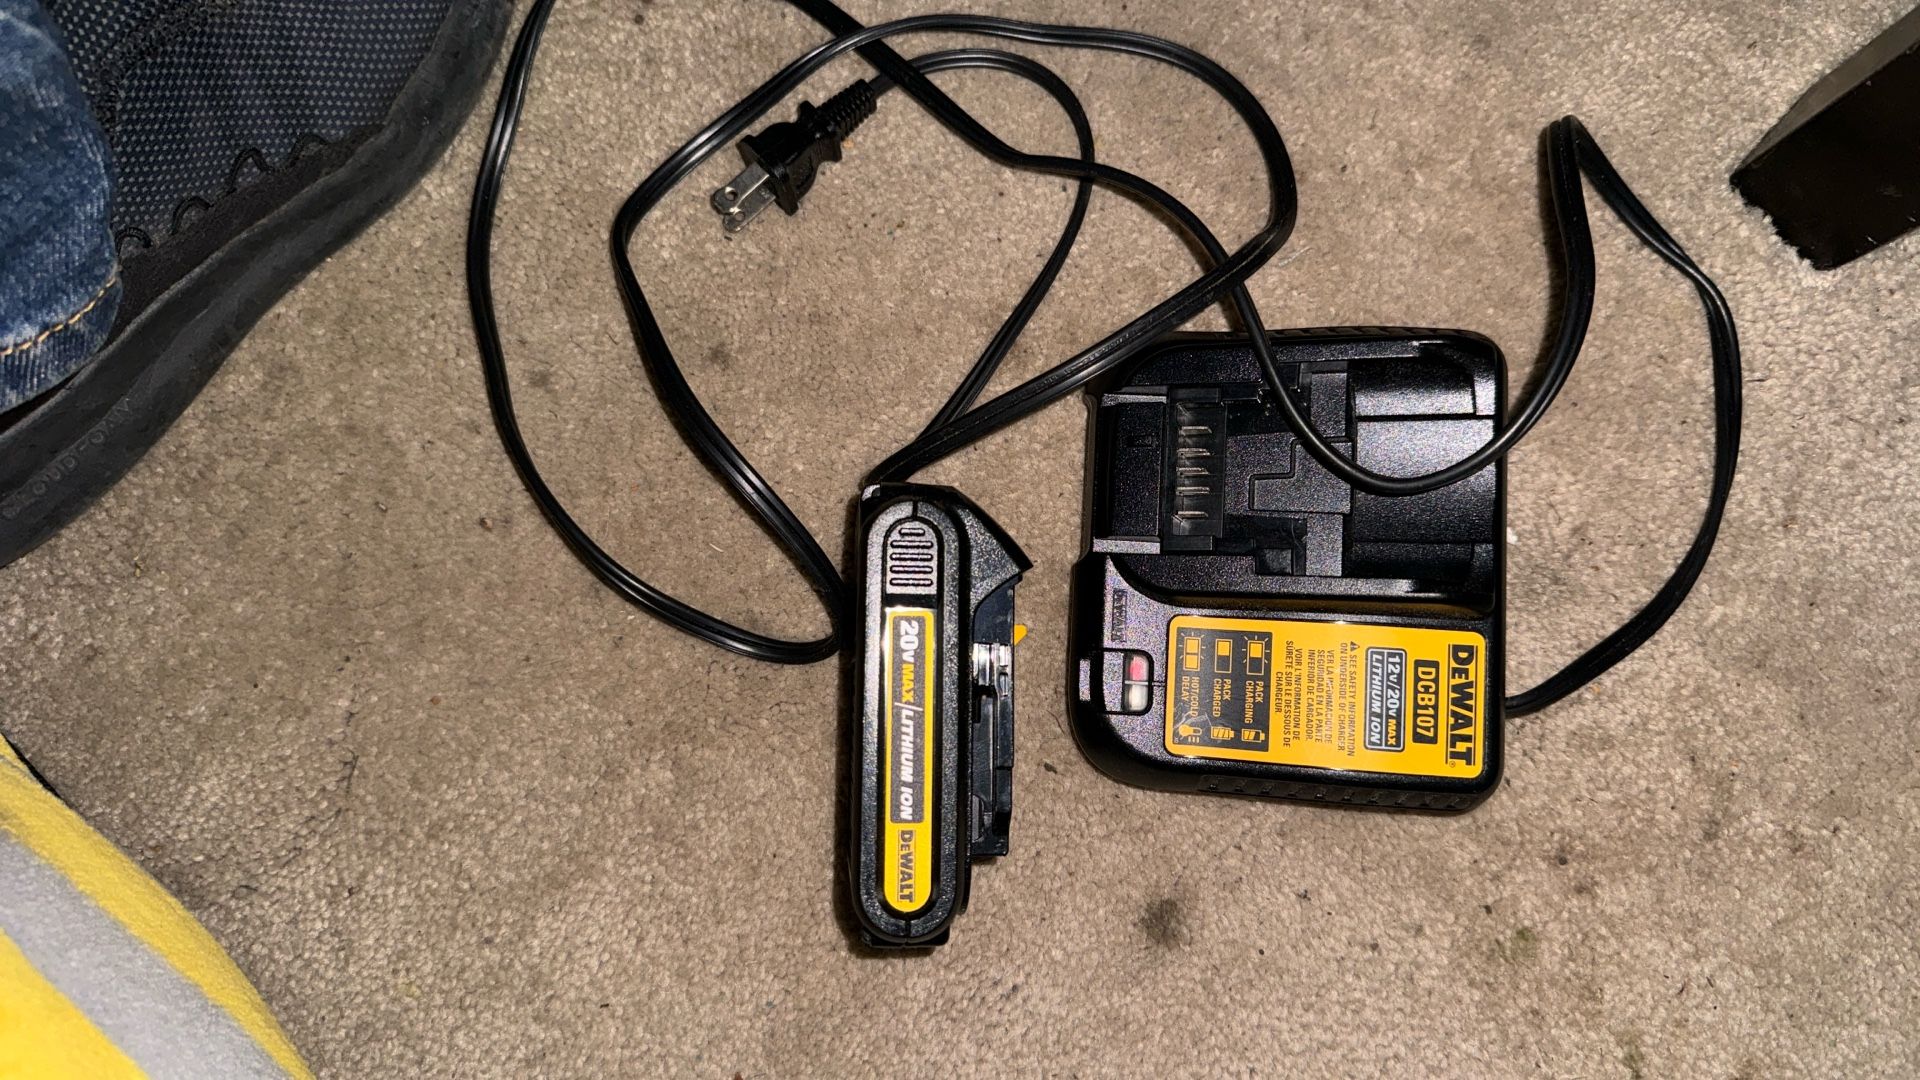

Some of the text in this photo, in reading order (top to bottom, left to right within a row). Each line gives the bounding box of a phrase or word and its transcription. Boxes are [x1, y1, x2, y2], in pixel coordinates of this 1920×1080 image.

[1341, 643, 1348, 654] ON
[1285, 671, 1293, 687] SUR
[1308, 649, 1316, 684] INFERIOR
[1327, 665, 1334, 675] LA
[1181, 676, 1190, 702] DELAY
[1190, 676, 1200, 719] HOT/COLD
[1212, 678, 1222, 717] CHARGED
[1223, 678, 1232, 701] PACK
[1244, 680, 1254, 724] CHARGING
[1255, 681, 1264, 703] PACK
[1284, 688, 1292, 697] LE
[1293, 648, 1303, 741] VOIR L'INFORMATION DE
[1307, 685, 1315, 696] DE
[1315, 649, 1325, 743] SEGURIDAD EN LA PARTE
[1370, 654, 1383, 744] LITHIUM ION
[1416, 666, 1436, 737] DCB107
[1284, 699, 1292, 735] DESSOUS
[1339, 702, 1347, 712] OF
[1348, 655, 1358, 757] SEE SAFETY INFORMATION
[1283, 737, 1291, 748] DE
[1325, 733, 1333, 744] DE
[1387, 718, 1397, 746] MAX
[900, 786, 914, 821] ION
